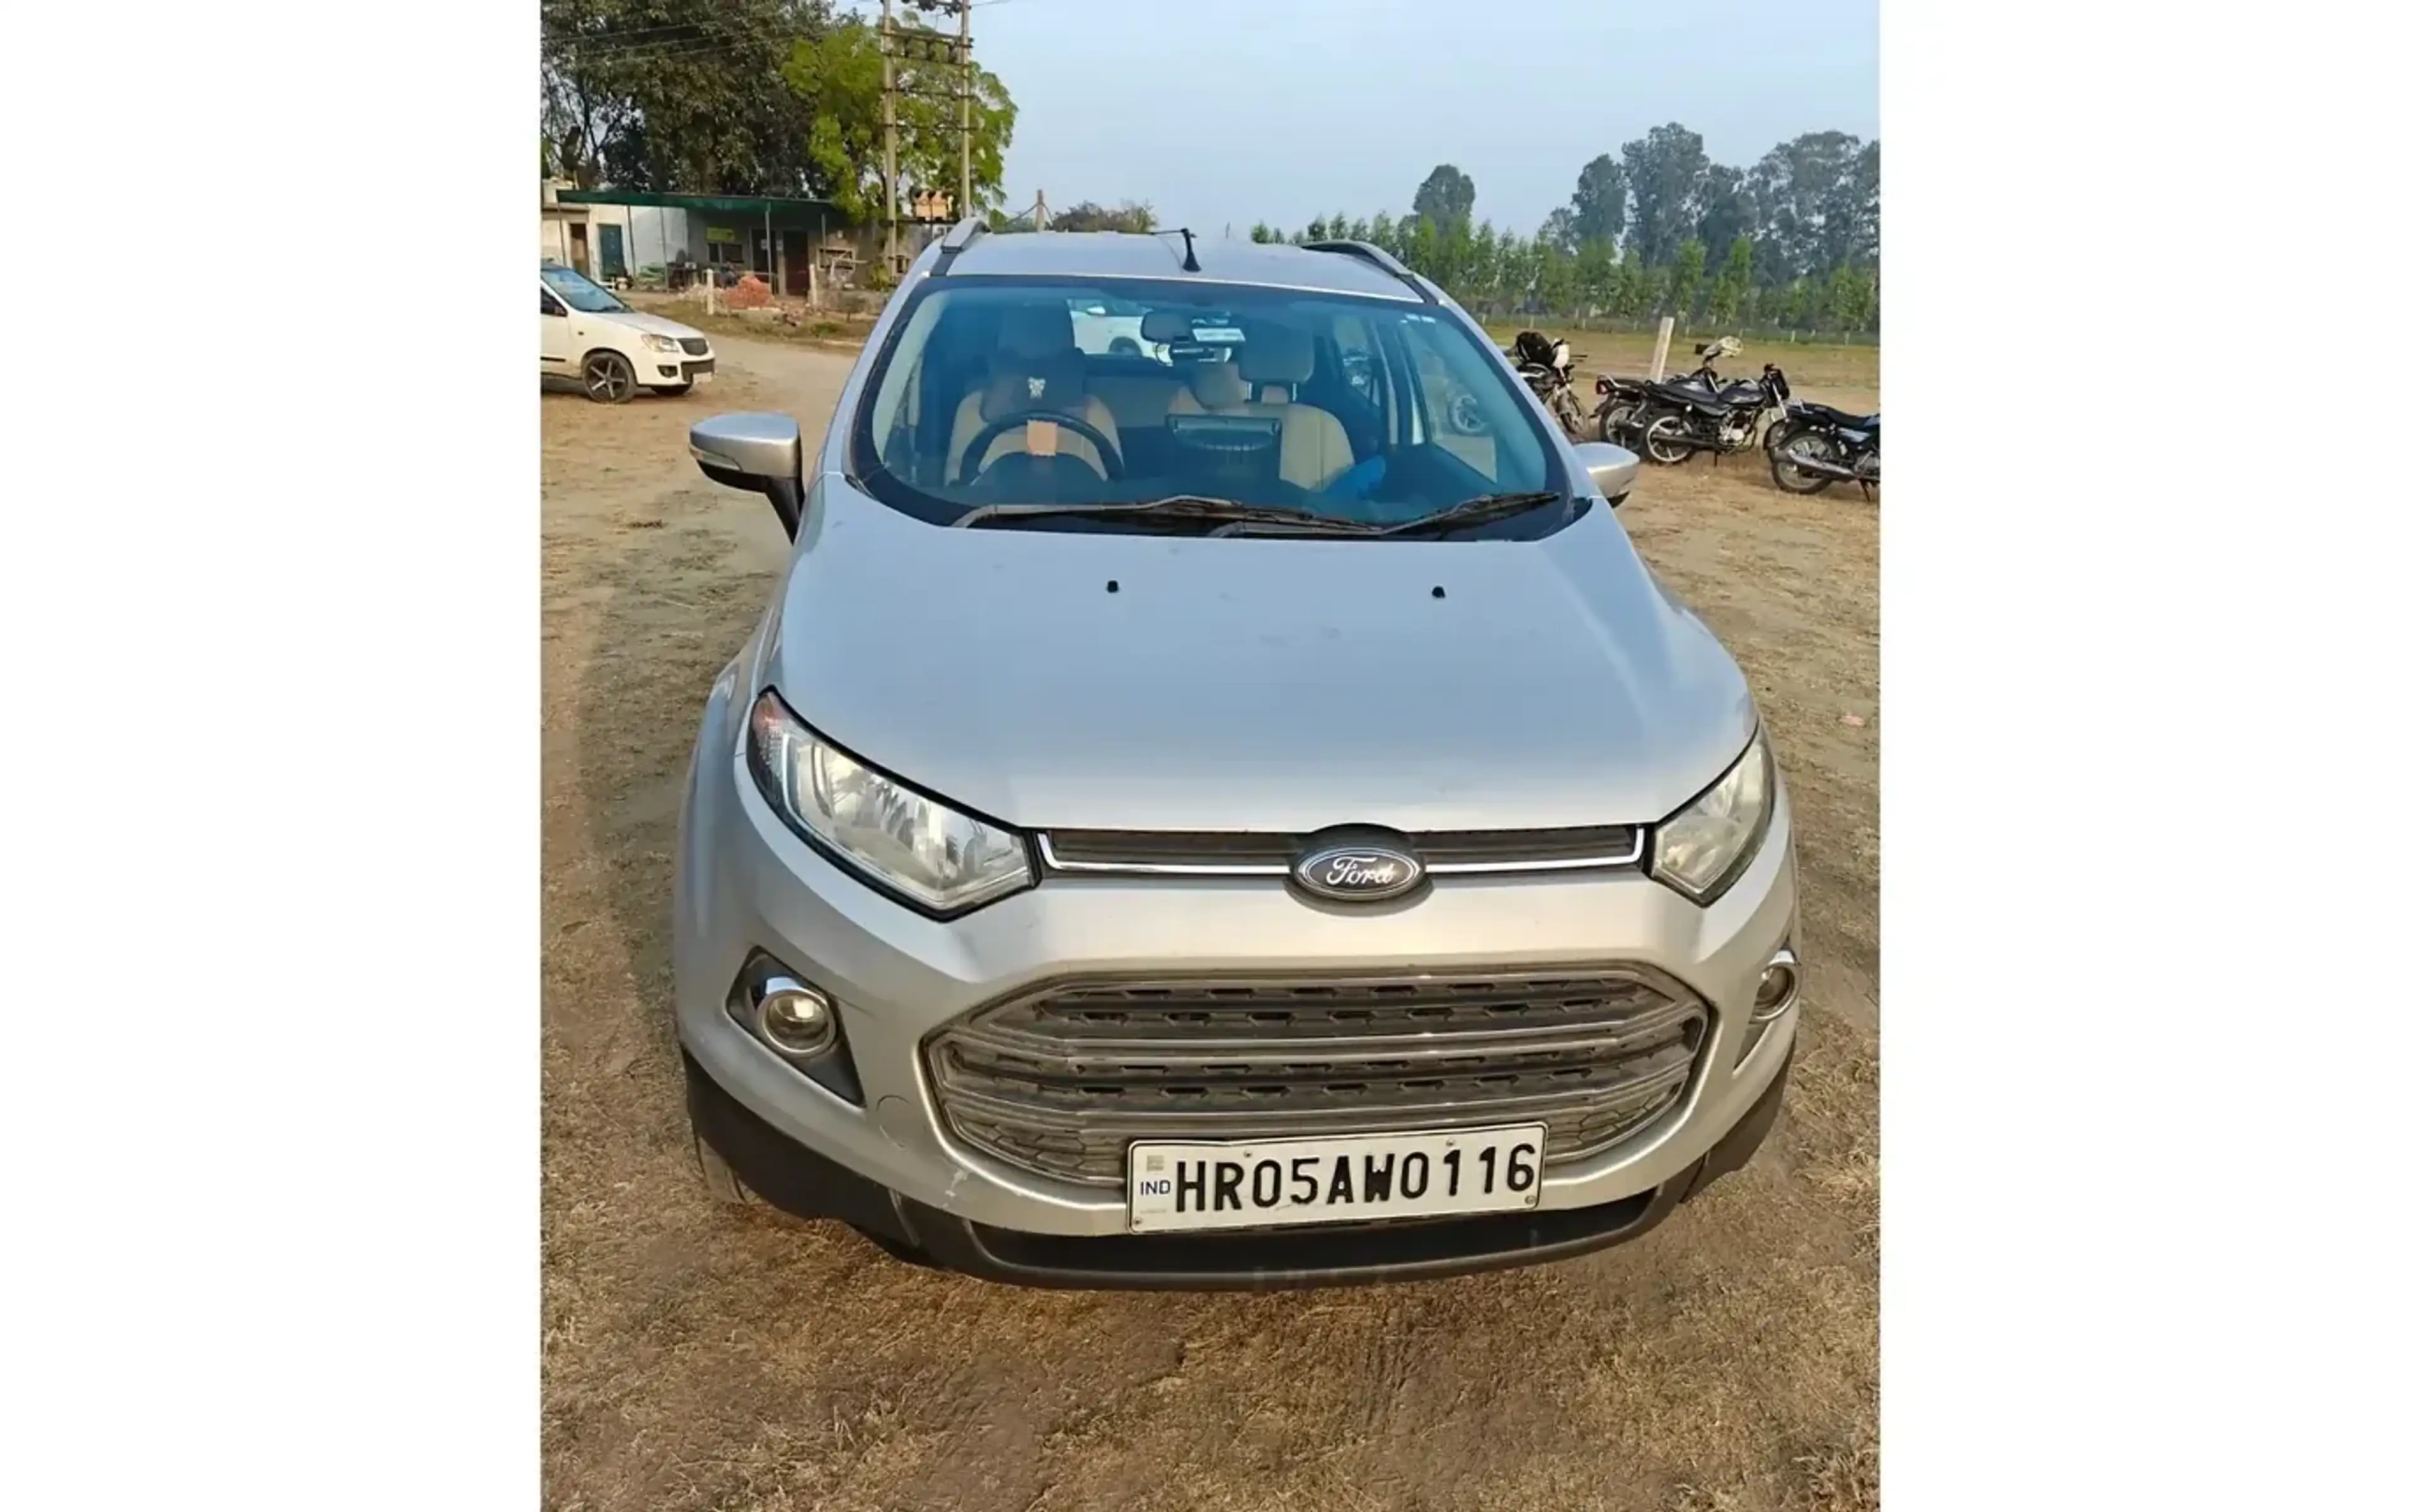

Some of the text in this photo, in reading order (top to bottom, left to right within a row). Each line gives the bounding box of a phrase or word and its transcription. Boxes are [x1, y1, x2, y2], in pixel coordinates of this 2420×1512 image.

[1326, 856, 1395, 885] Ford
[1141, 1179, 1170, 1196] IND
[1176, 1143, 1535, 1213] HR05AW0116
